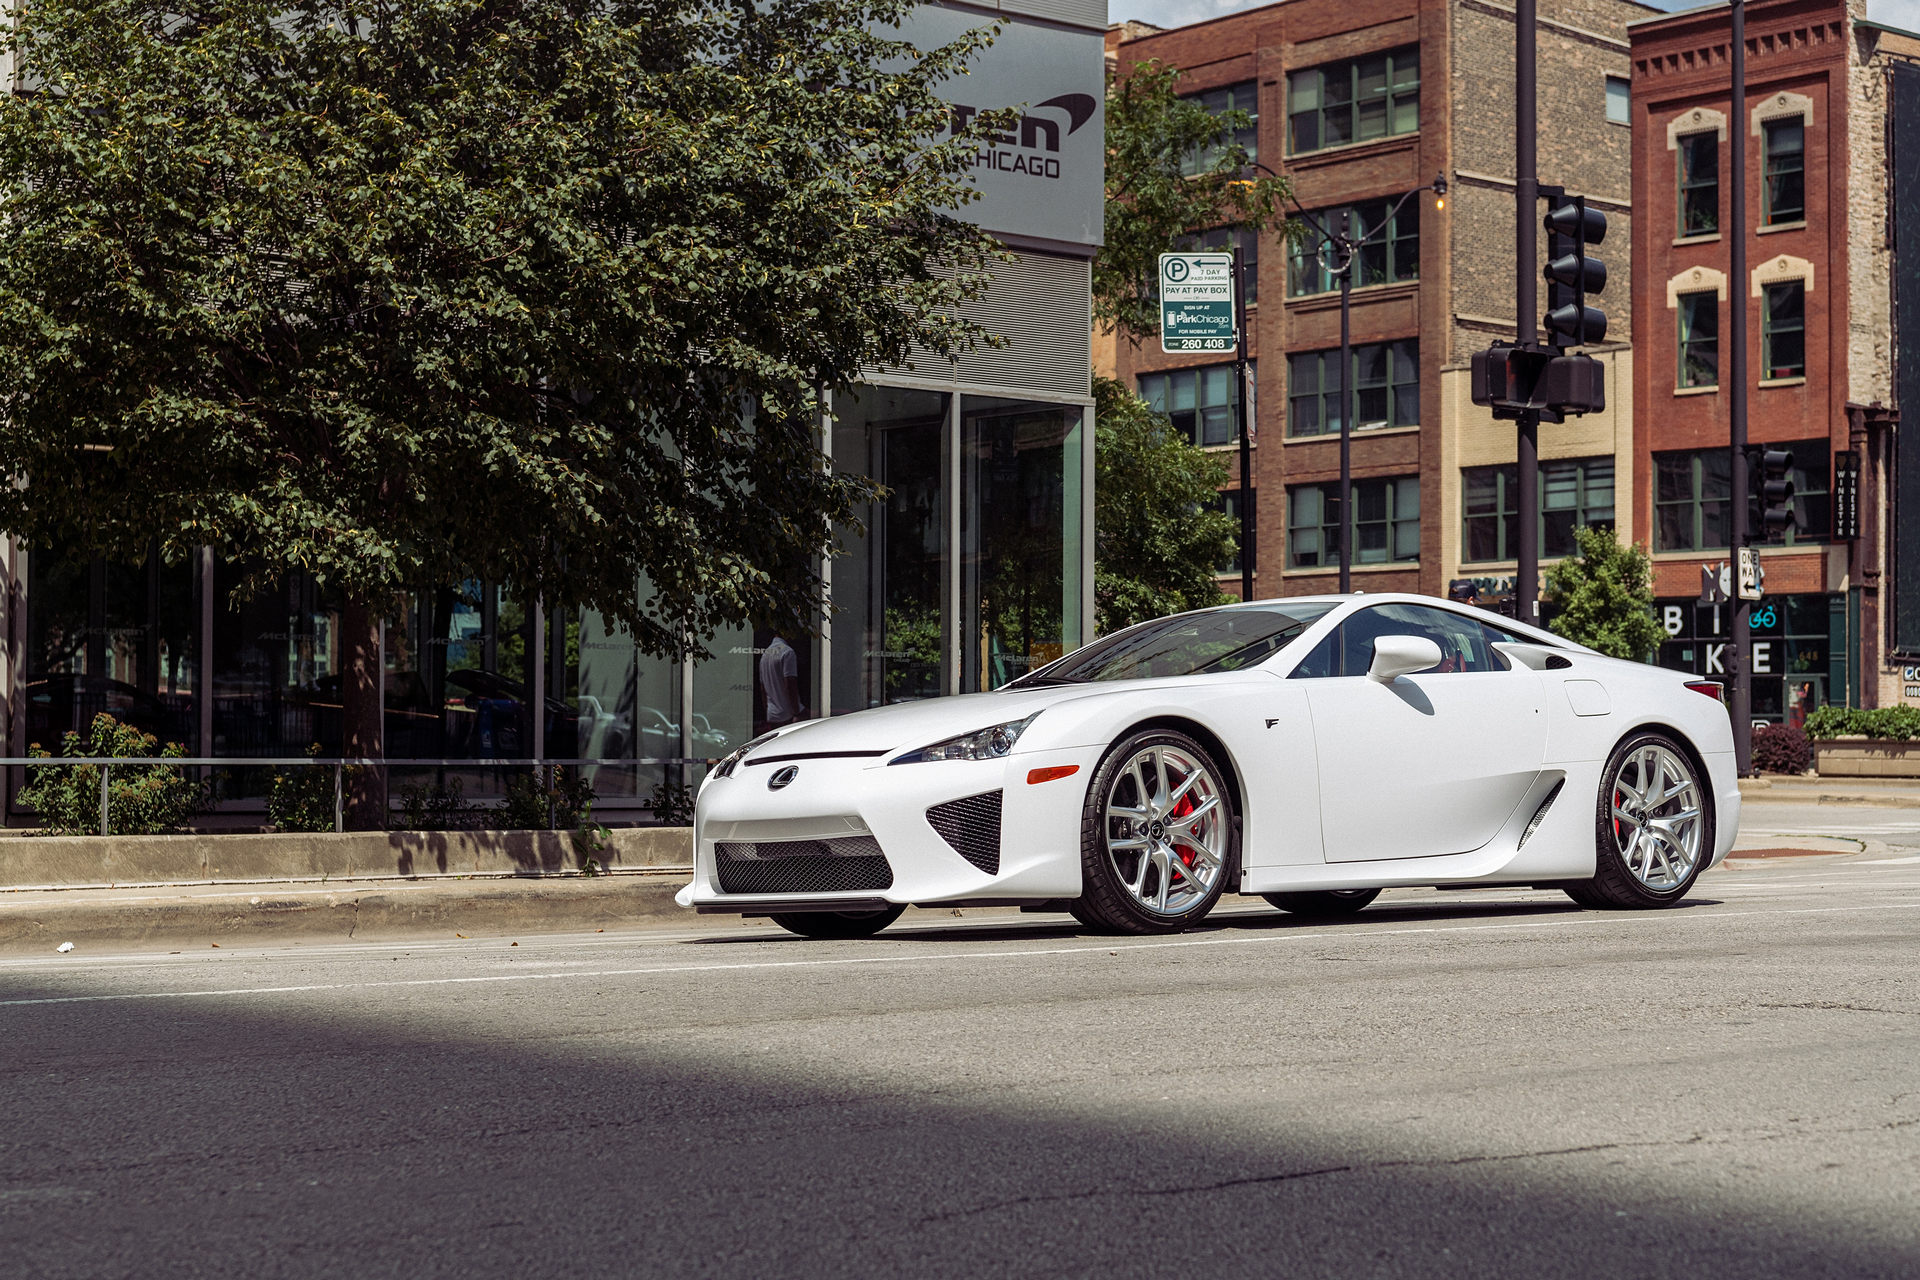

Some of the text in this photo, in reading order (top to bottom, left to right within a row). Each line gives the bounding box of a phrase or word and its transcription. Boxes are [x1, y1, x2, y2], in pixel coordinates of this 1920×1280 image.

[1165, 286, 1228, 294] PAY AT PAY BOX
[1176, 314, 1230, 325] ParkChicago
[1181, 339, 1202, 349] 260
[1204, 339, 1225, 349] 408
[1837, 470, 1846, 536] WINESTYR
[1849, 470, 1857, 536] WINESTYR
[1741, 552, 1758, 566] ONE
[1741, 567, 1758, 578] WAY
